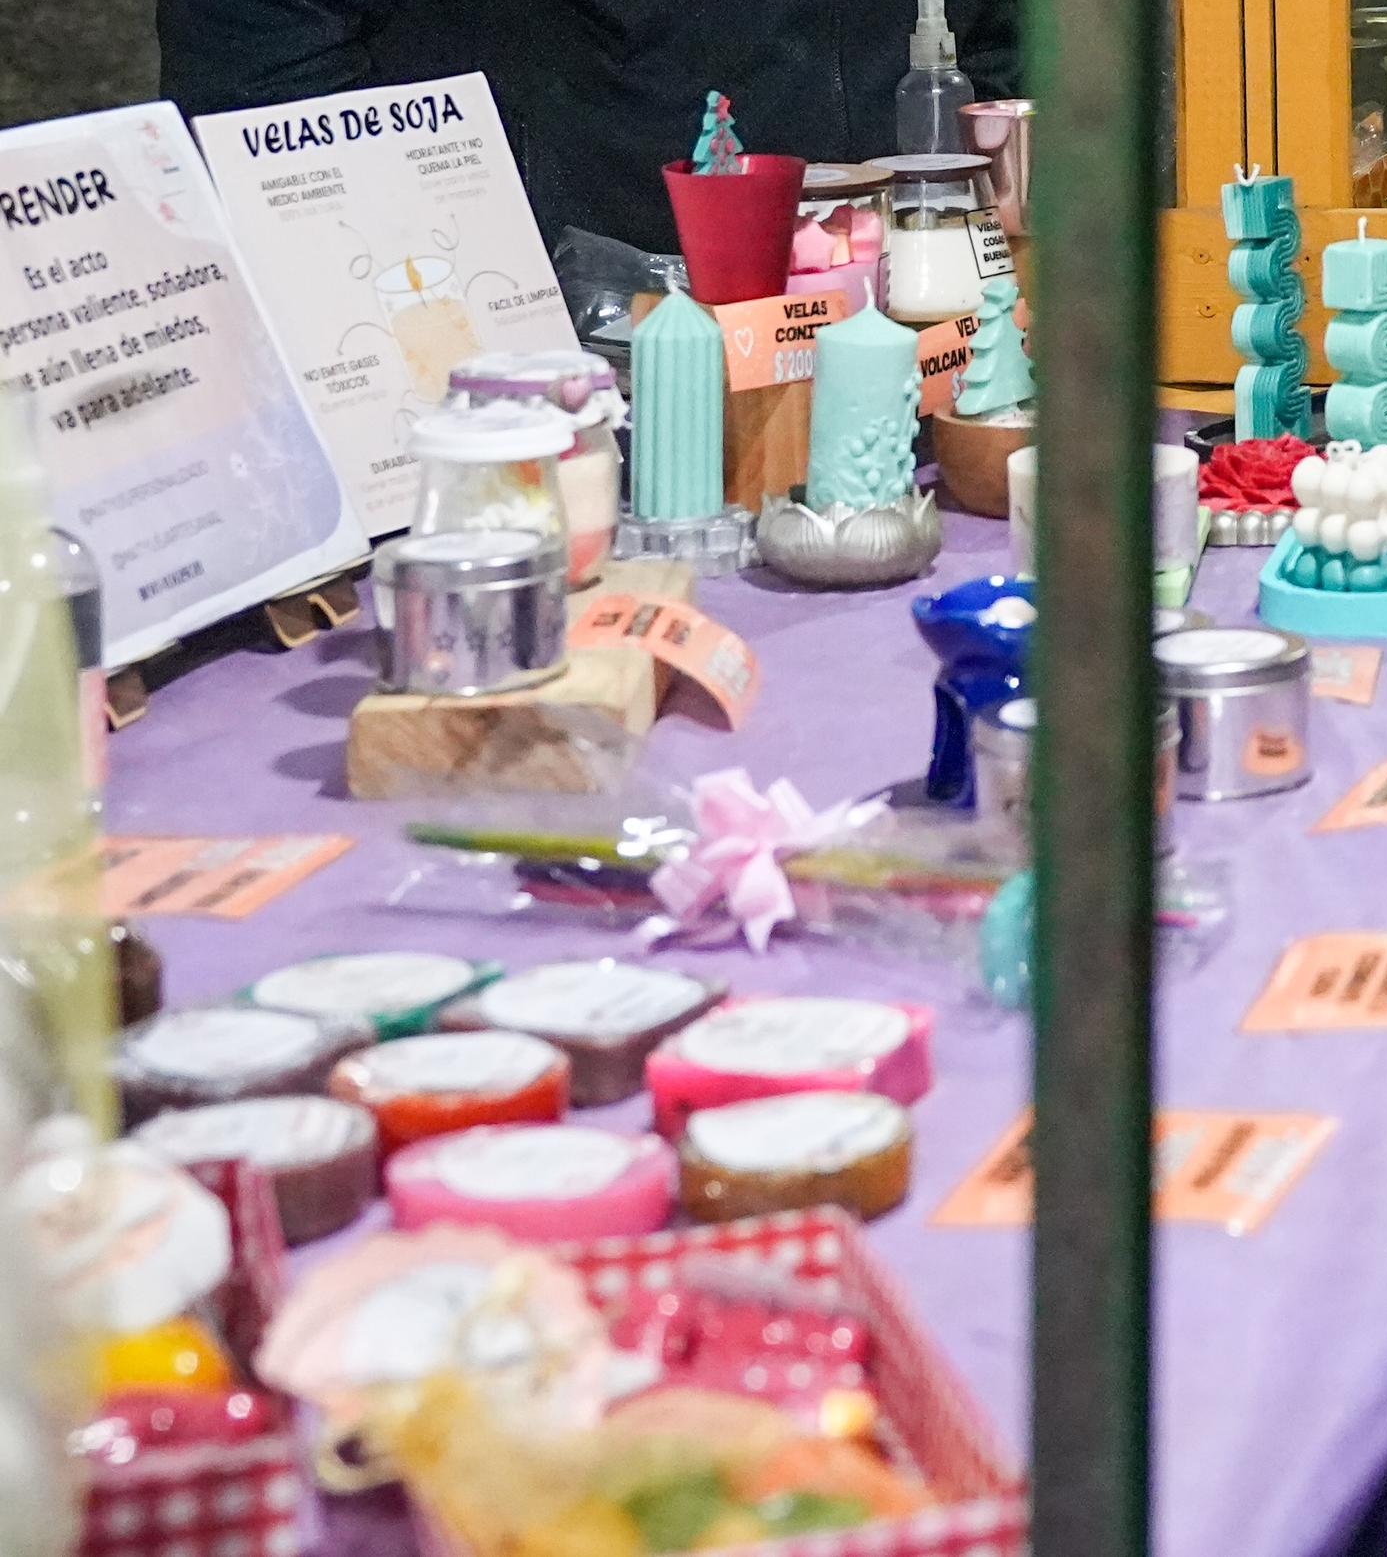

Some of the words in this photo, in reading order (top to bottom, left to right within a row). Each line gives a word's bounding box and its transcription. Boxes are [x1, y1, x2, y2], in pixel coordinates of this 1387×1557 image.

[242, 114, 334, 157] VELAS
[340, 106, 383, 141] DE
[390, 93, 464, 133] SOJA
[261, 172, 308, 191] AMIGABLE
[0, 169, 118, 230] RENDER
[783, 300, 828, 319] VELAS
[775, 322, 831, 343] CONI
[955, 316, 981, 338] VEL
[787, 348, 817, 379] 200
[920, 347, 968, 377] VOLCAN
[371, 454, 419, 474] DURABIL
